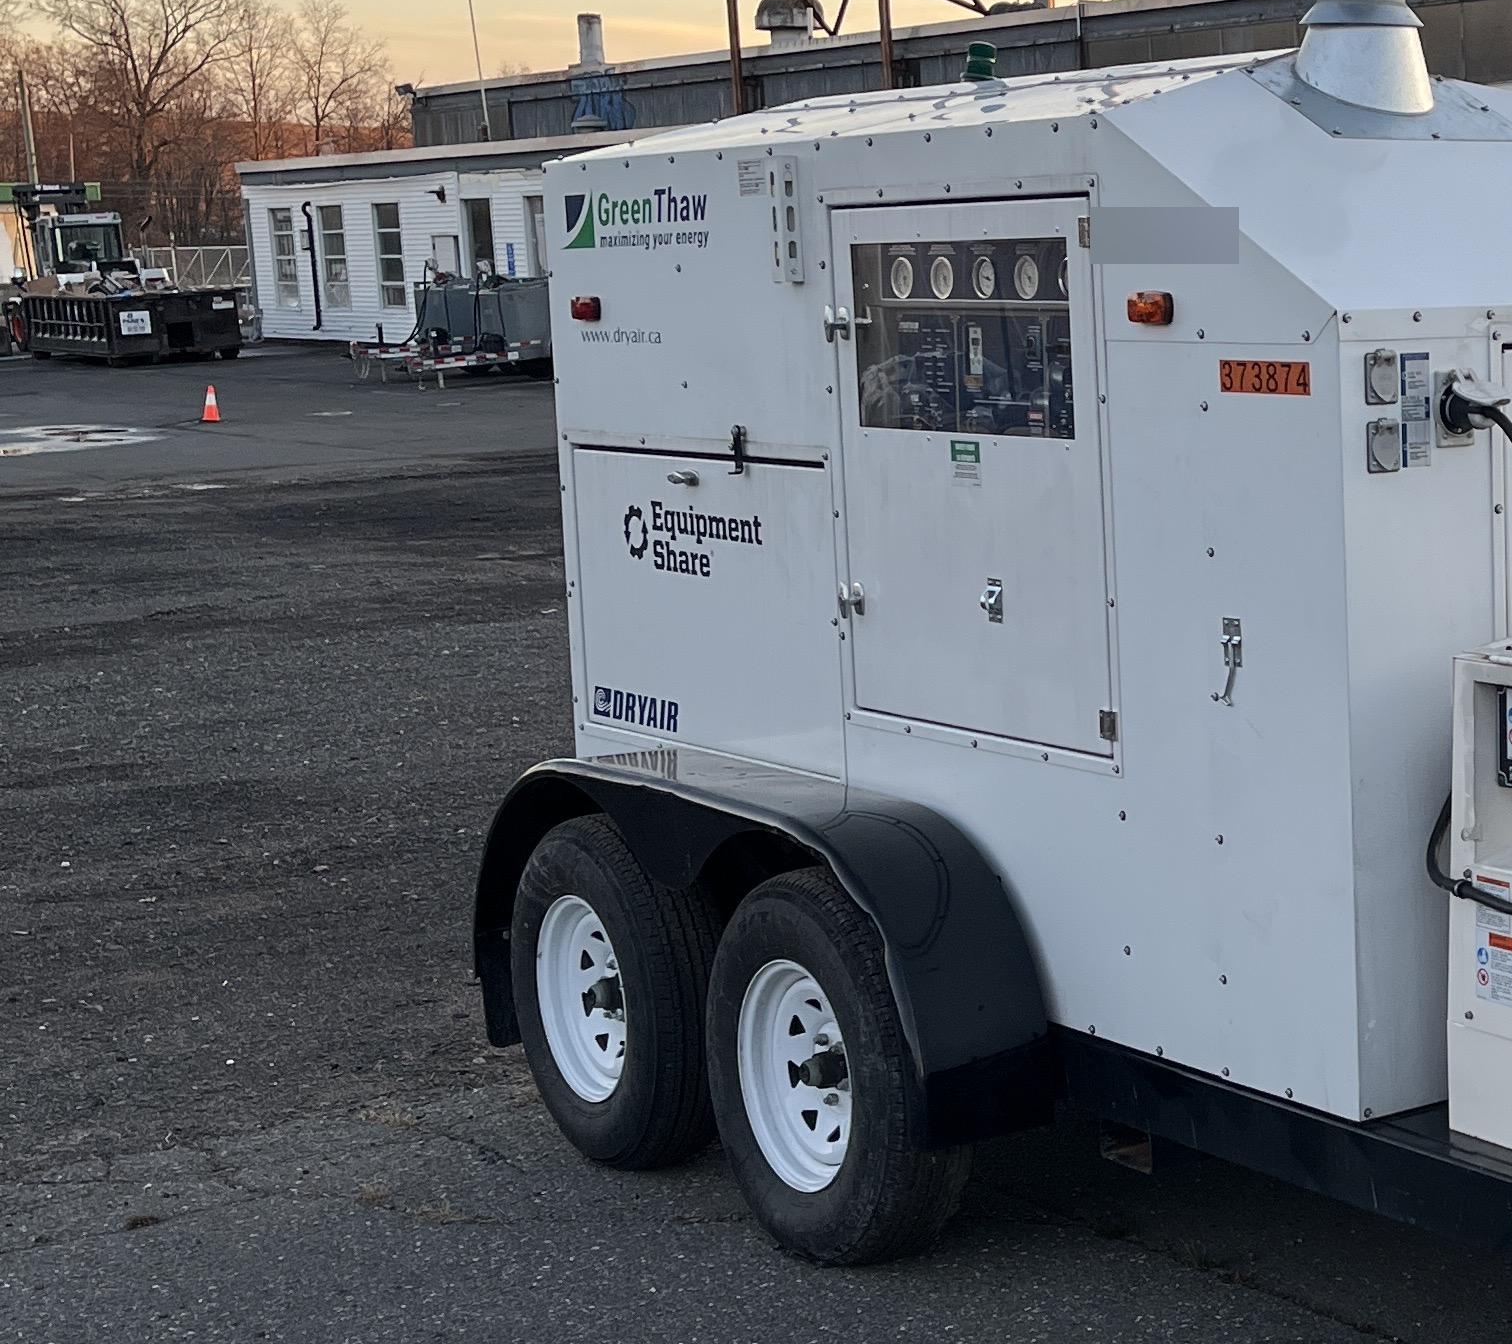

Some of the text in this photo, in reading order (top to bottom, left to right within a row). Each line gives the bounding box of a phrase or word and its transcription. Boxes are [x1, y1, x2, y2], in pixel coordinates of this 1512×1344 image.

[598, 186, 708, 227] GreenThaw
[600, 230, 710, 250] maximizing your energy
[581, 326, 662, 346] www.dryair.ca
[1222, 362, 1309, 393] 373874
[651, 500, 763, 545] Equipment
[653, 539, 711, 578] Share
[613, 690, 679, 733] DRYAIR
